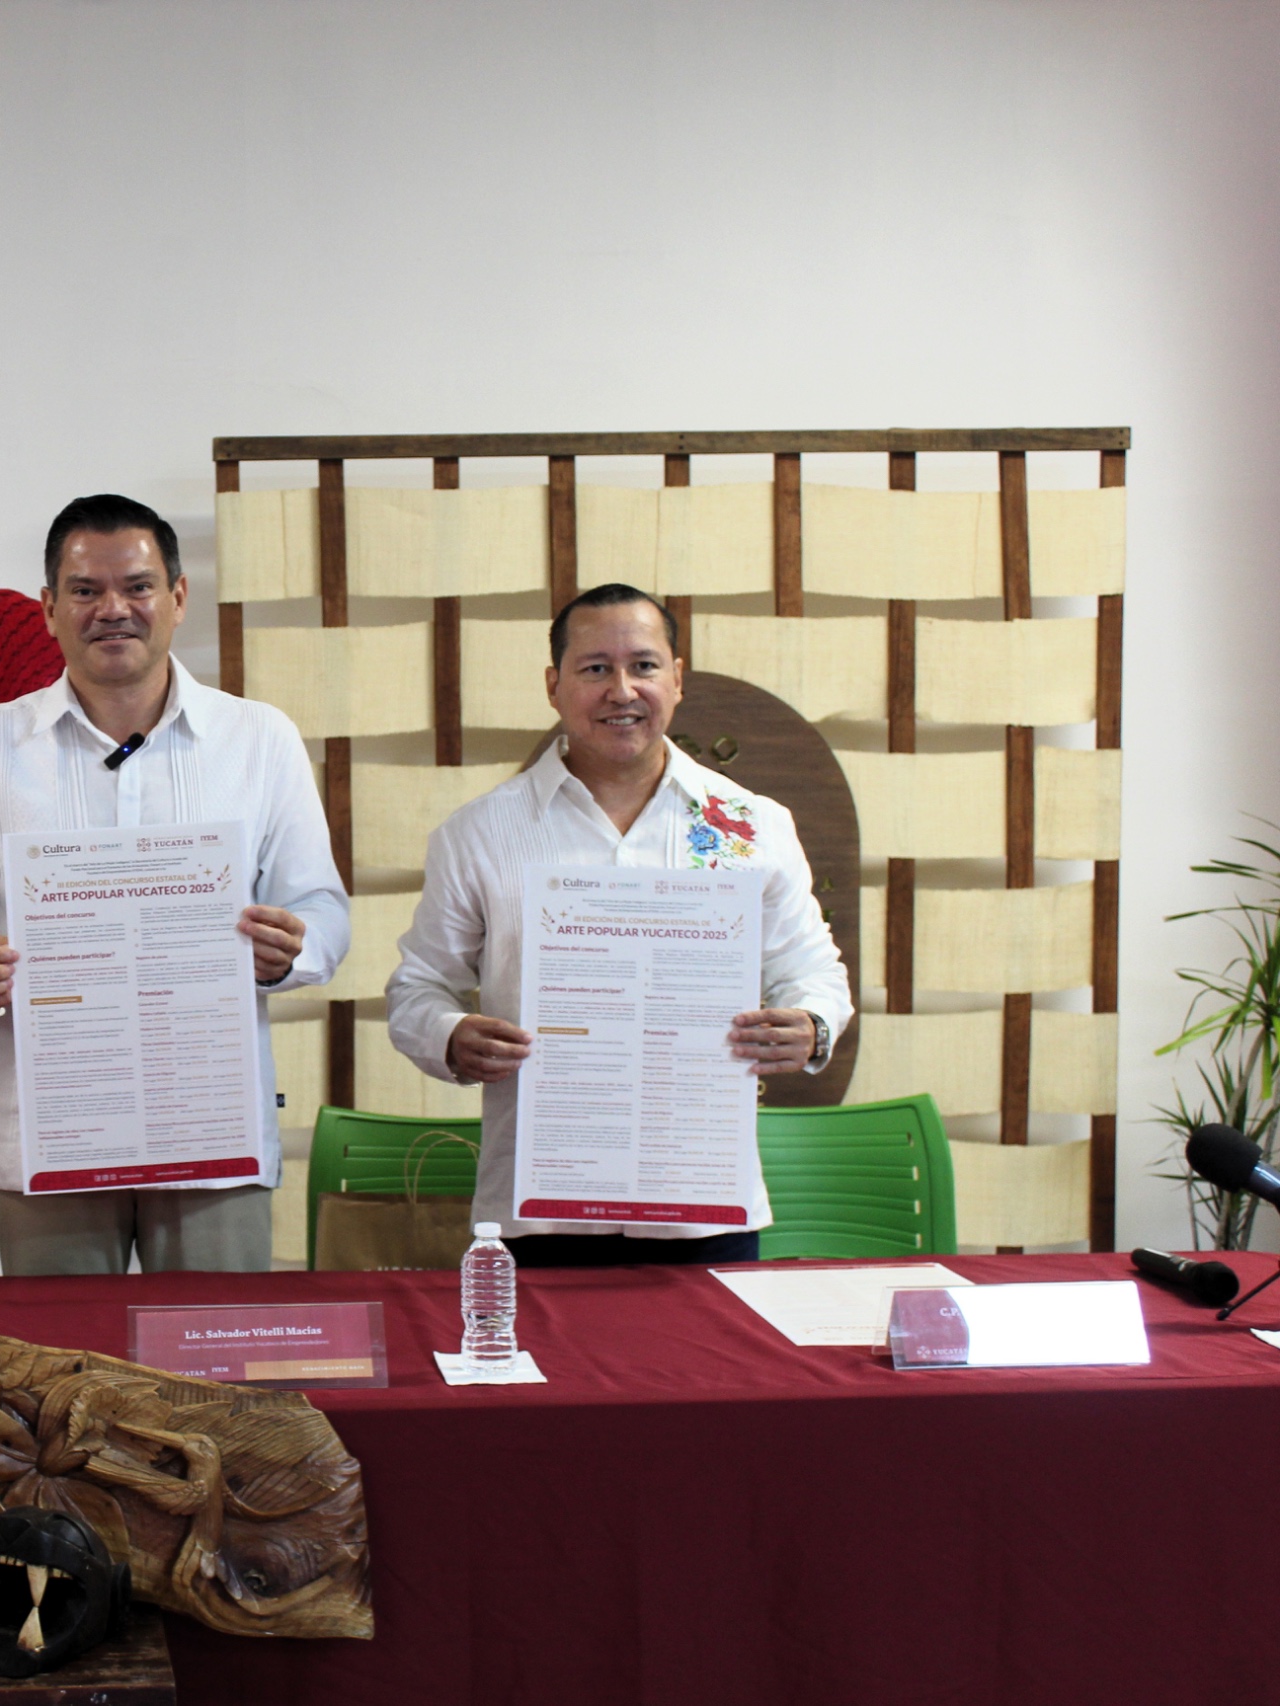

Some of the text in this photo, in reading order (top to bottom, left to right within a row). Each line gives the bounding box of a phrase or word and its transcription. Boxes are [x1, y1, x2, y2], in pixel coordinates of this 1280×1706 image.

[43, 844, 81, 854] Cultura
[41, 884, 215, 902] ARTE POPULAR YUCATECO 2025
[25, 913, 56, 921] Objetivos
[557, 926, 727, 940] ARTE POPULAR YUCATECO 2025
[185, 1326, 322, 1339] Lic. Salvador Vitelli Macías
